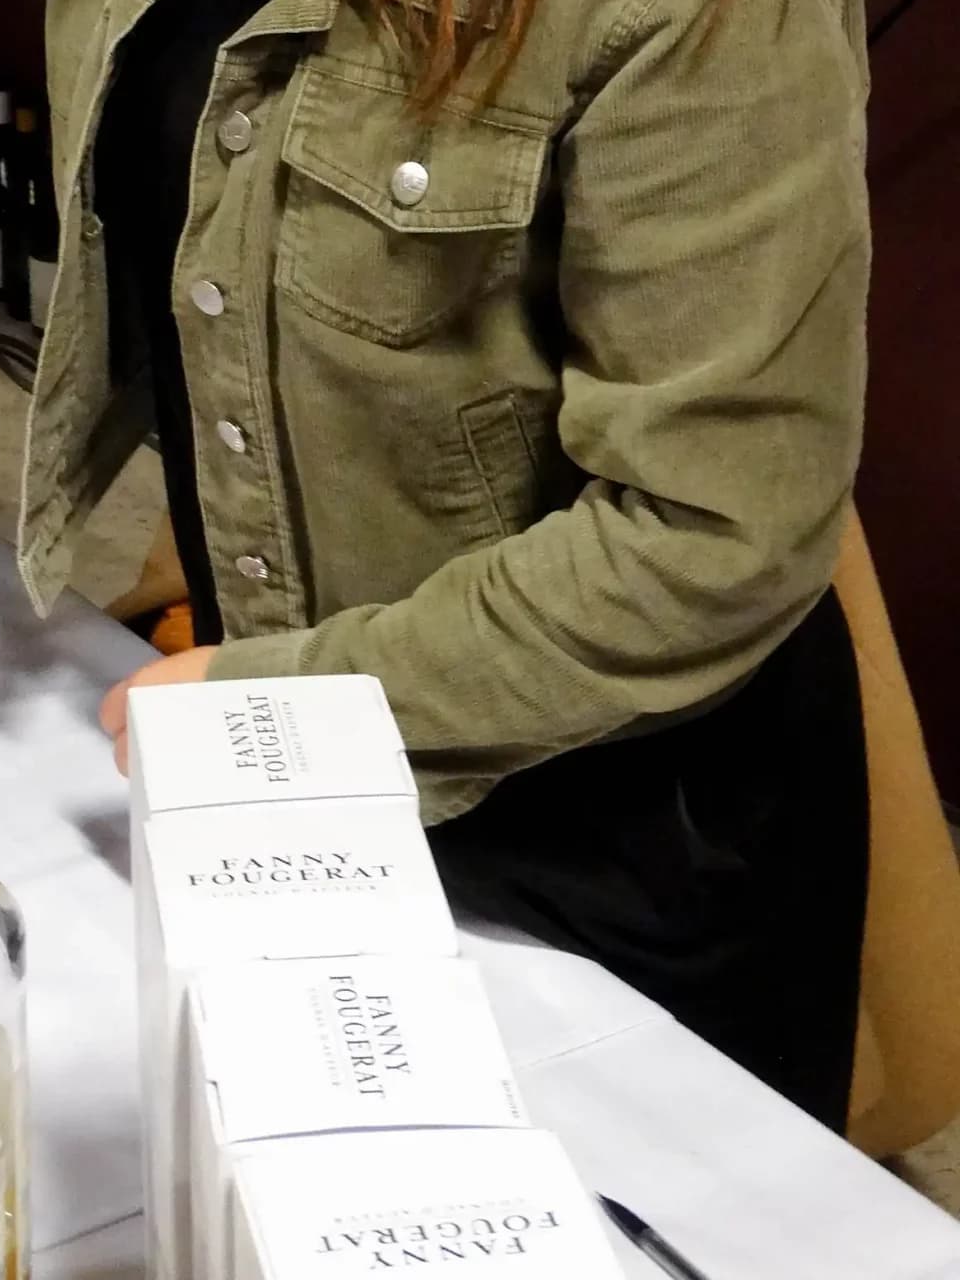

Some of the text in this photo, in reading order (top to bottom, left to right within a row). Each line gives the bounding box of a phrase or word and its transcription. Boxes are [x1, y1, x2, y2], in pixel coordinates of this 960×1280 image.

[224, 710, 259, 768] FANNY
[246, 694, 290, 783] FOUGERAT
[188, 864, 394, 886] FOUGERAT
[221, 852, 352, 870] FANNY
[328, 975, 386, 1099] FOUGERAT
[365, 994, 411, 1074] FANNY
[316, 1211, 560, 1253] FOUGERAT
[369, 1236, 526, 1270] FANNY
